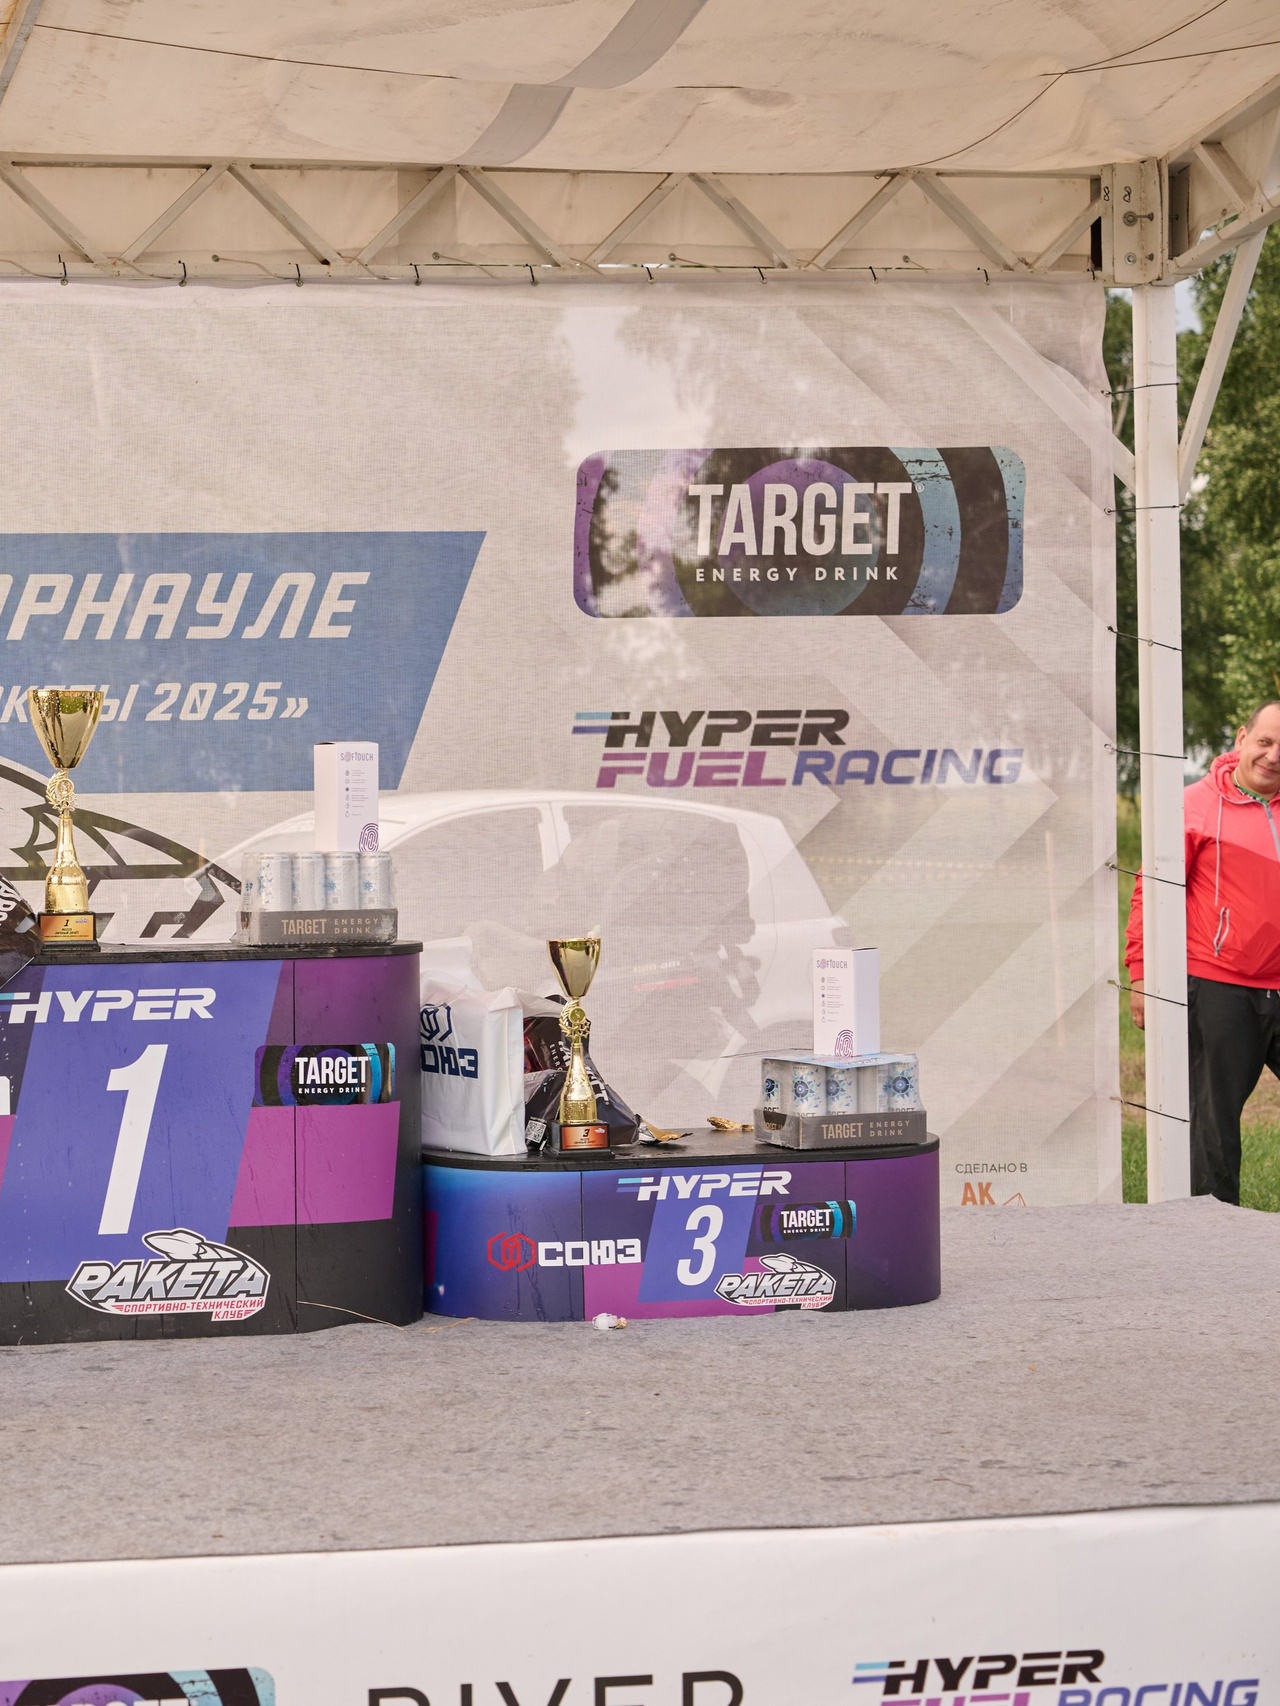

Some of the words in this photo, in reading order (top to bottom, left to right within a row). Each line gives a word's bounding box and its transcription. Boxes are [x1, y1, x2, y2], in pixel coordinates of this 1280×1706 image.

[688, 482, 913, 556] TARGET
[695, 566, 800, 583] ENERGY
[815, 565, 899, 582] DRINK
[602, 709, 850, 748] HYPER
[596, 750, 787, 789] FUEL
[792, 748, 1024, 787] RACING
[281, 918, 327, 935] TARGET
[334, 917, 379, 925] ENERGY
[7, 987, 217, 1024] HYPER
[294, 1056, 370, 1085] TARGET
[98, 1044, 169, 1236] 1
[821, 1122, 864, 1139] TARGET
[869, 1120, 910, 1128] ENERGY
[869, 1129, 903, 1137] DRINK
[955, 1163, 1017, 1174] СДЕЛАНО
[637, 1171, 792, 1201] HYPER
[780, 1209, 832, 1228] TARGET
[537, 1238, 642, 1267] СОЮЗ
[676, 1204, 724, 1286] 3
[71, 1260, 265, 1302] РАКЕТА
[720, 1272, 834, 1299] РАКЕТА
[123, 1298, 264, 1313] СПОРТИВНО-ТЕХНИЧЕСКИЙ
[213, 1310, 243, 1319] КЛУБ
[748, 1295, 833, 1306] СПОРТИВНО-ТЕХНИЧЕСКИЙ
[882, 1649, 1106, 1696] HYPER
